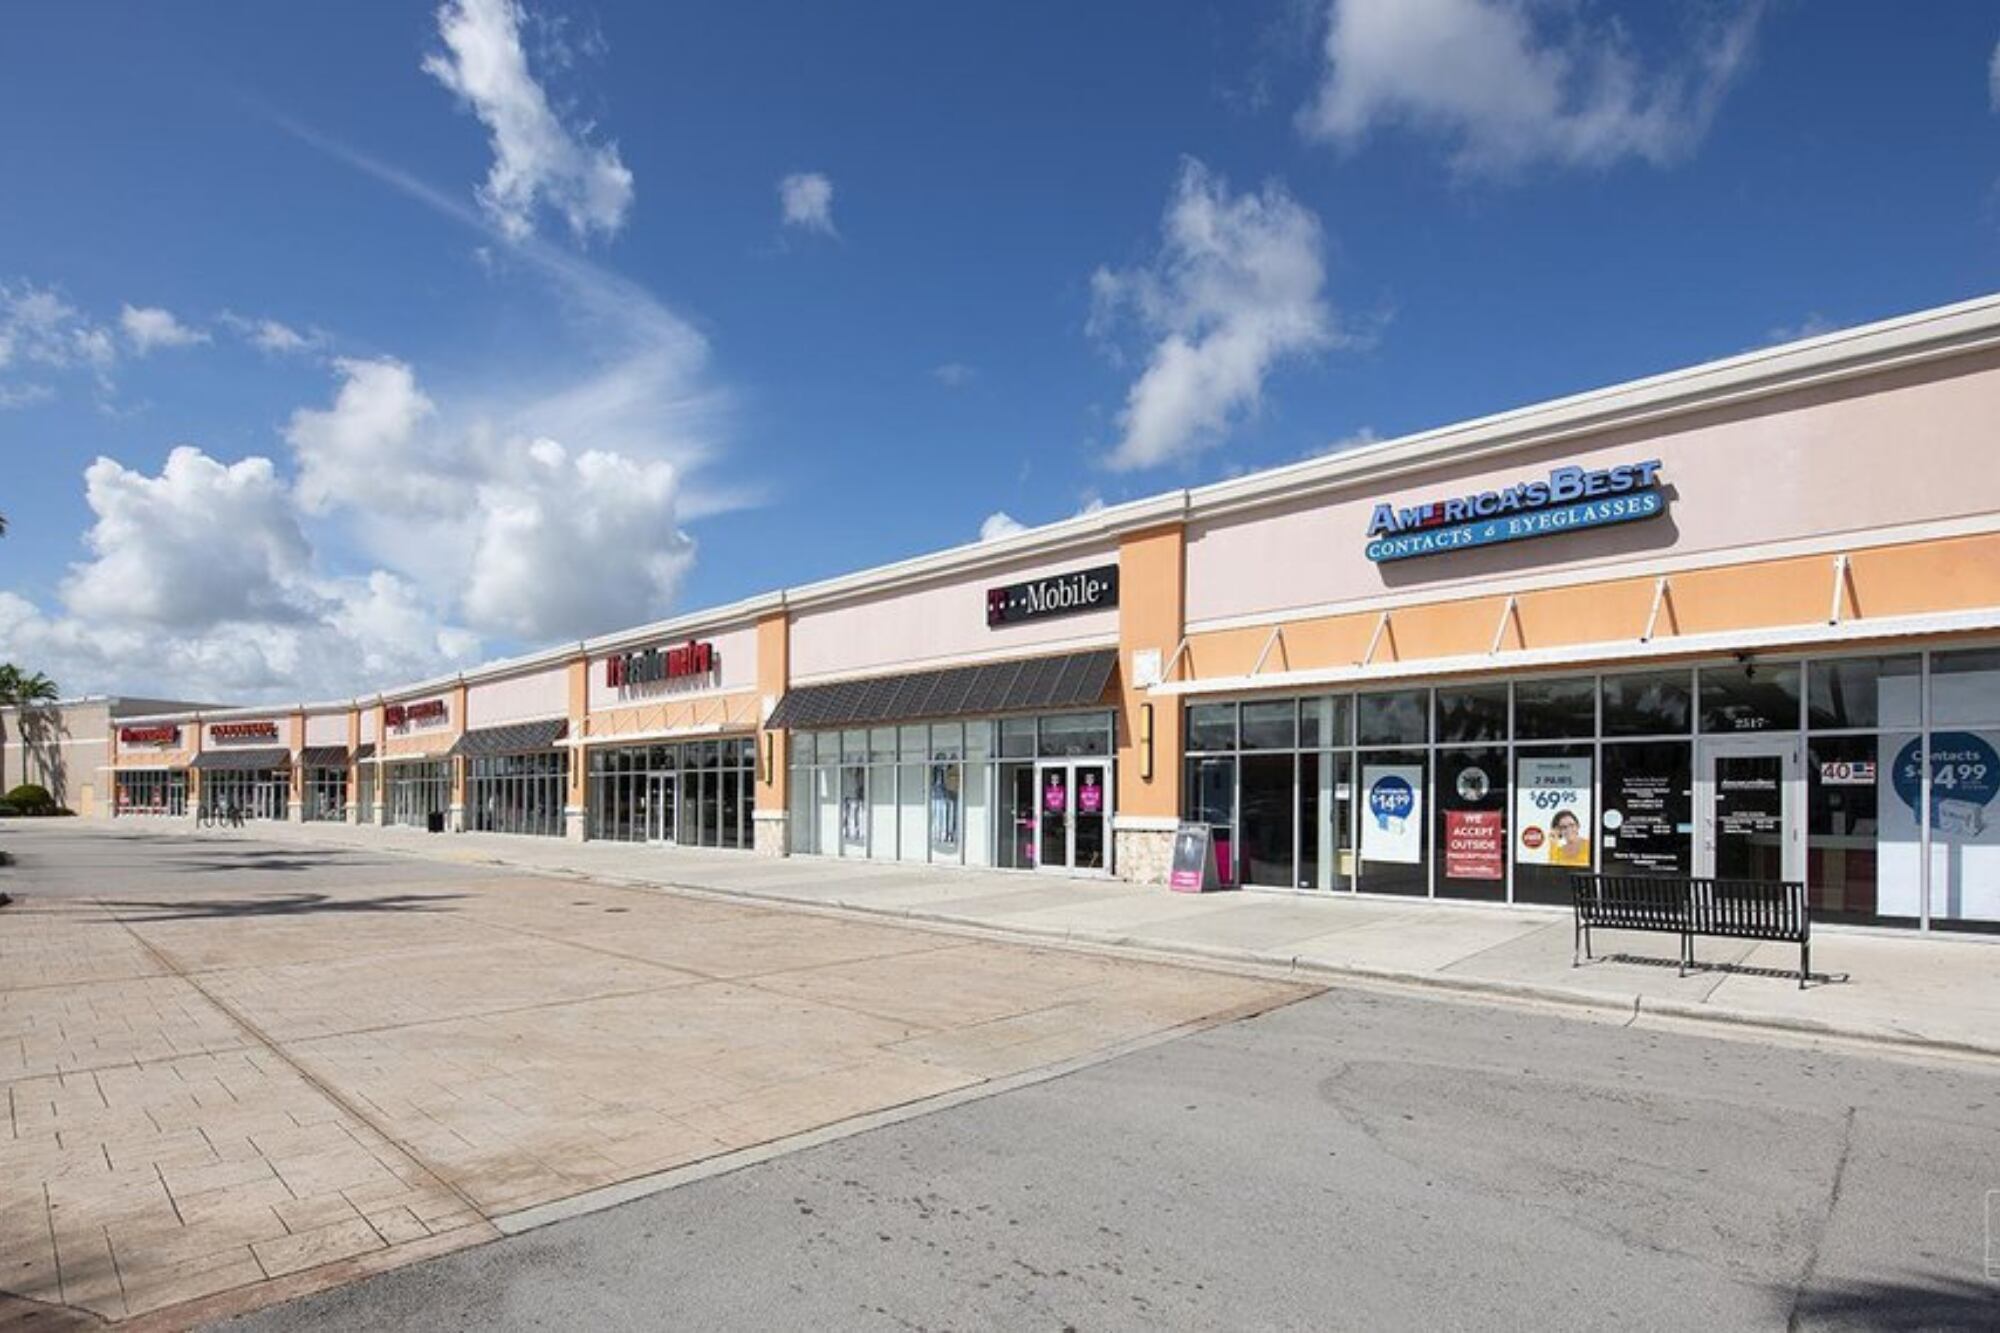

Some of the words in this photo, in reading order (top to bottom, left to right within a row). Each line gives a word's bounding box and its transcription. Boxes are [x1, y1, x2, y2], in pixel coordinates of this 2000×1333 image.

[1369, 528, 1472, 557] CONTACTS
[1509, 495, 1655, 534] EYEGLASSES
[1911, 750, 1980, 761] Cntacts
[1463, 814, 1482, 825] WE
[1453, 827, 1494, 837] ACCEPT
[1451, 839, 1496, 850] OUTSIDE
